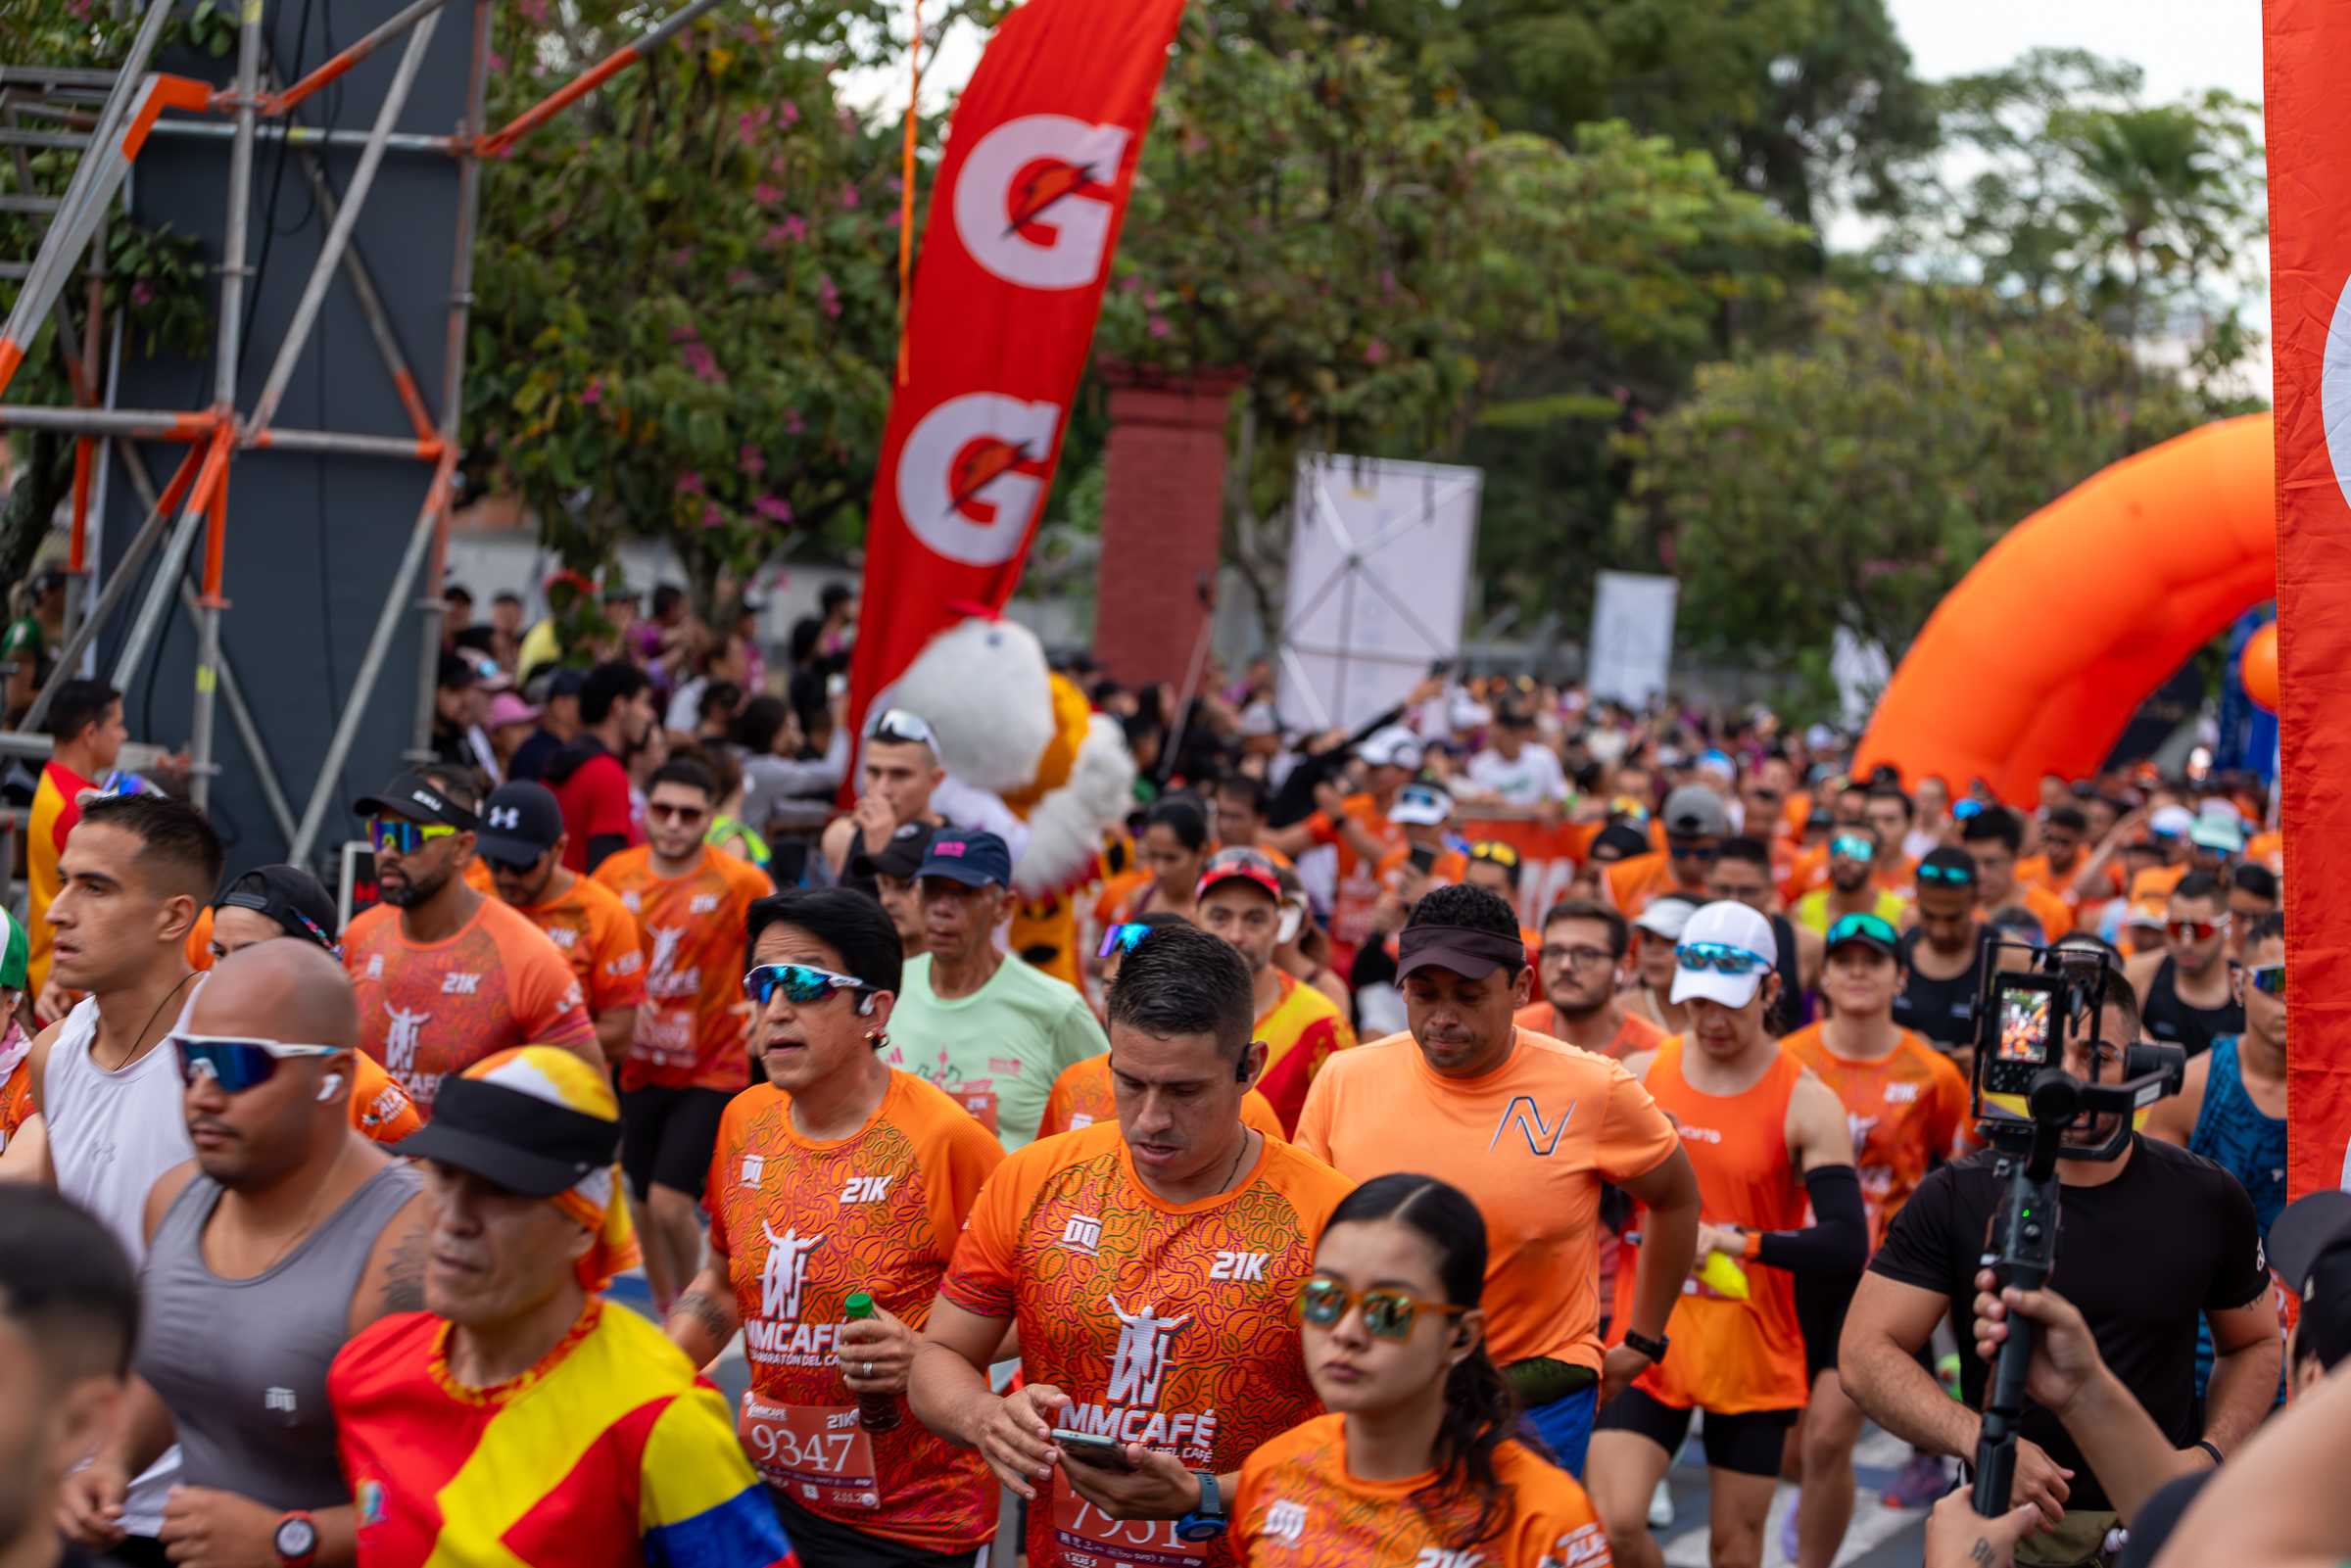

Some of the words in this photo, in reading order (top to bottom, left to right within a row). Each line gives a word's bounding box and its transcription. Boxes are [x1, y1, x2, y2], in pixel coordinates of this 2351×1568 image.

[953, 113, 1133, 290] G
[896, 391, 1061, 566] G
[441, 973, 482, 994] 21K
[839, 1175, 893, 1204] 21K
[1209, 1252, 1271, 1282] 21K
[750, 1423, 855, 1473] 9347
